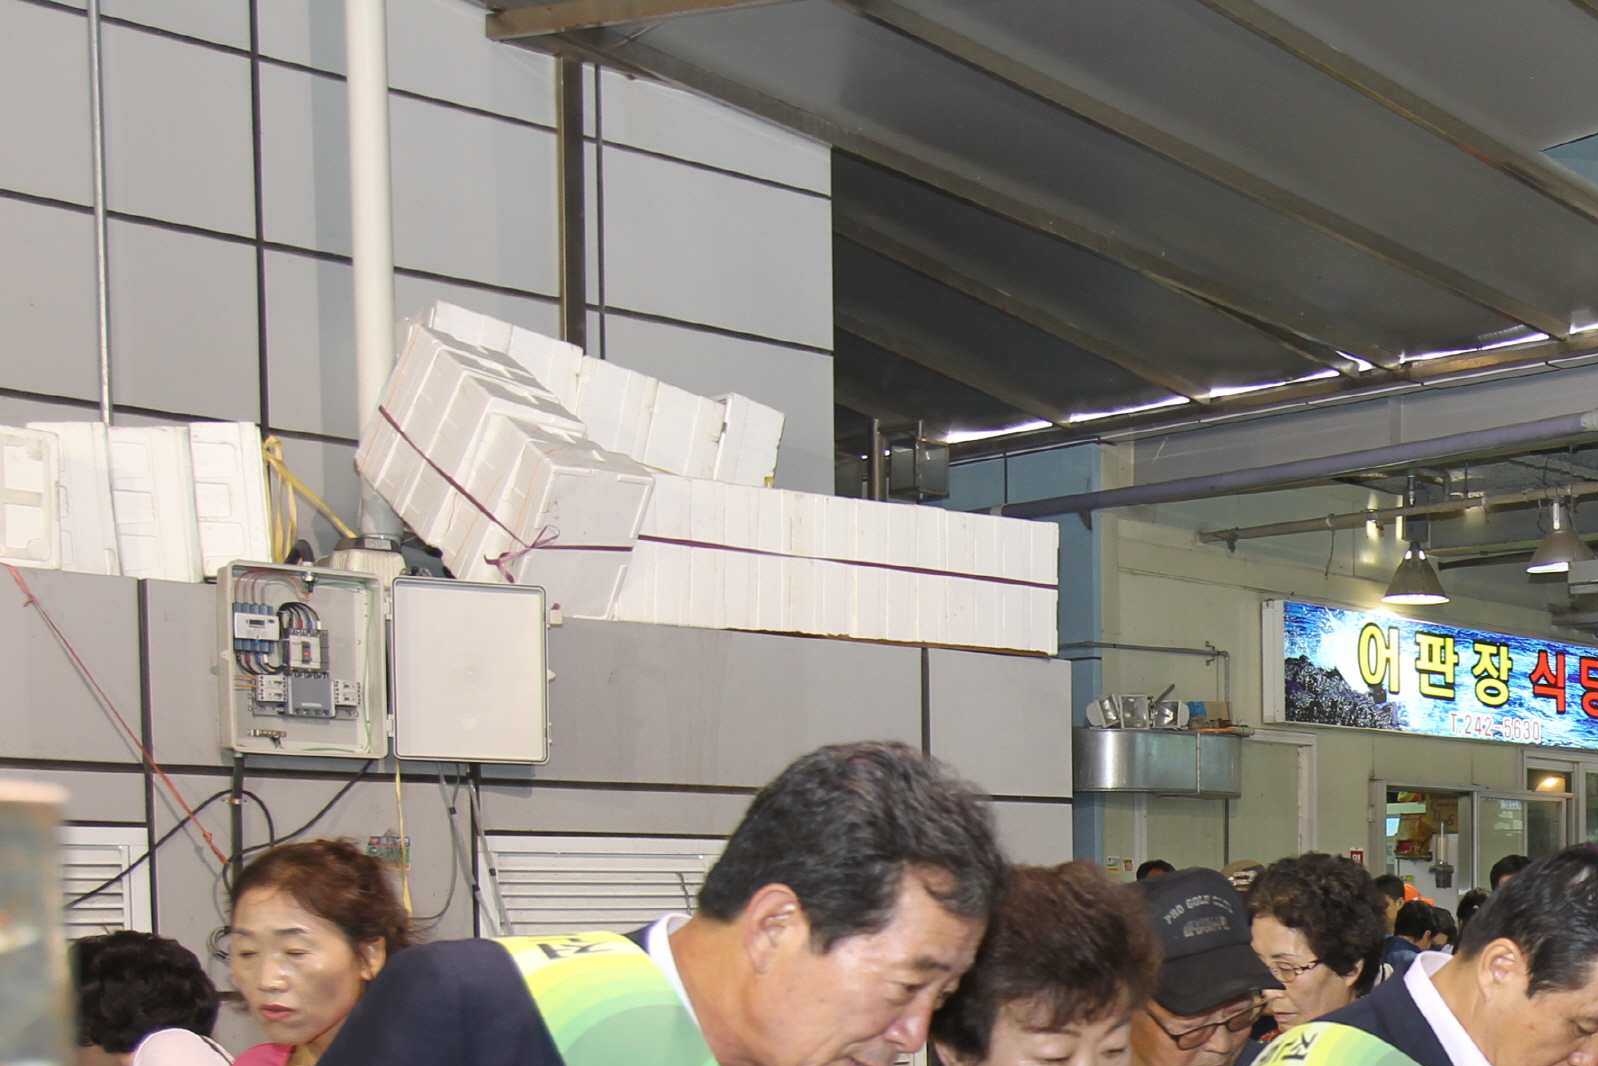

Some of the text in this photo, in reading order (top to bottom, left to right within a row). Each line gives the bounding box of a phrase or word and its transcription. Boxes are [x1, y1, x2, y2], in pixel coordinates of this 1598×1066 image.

[1358, 621, 1513, 708] 어판장
[1450, 711, 1542, 742] T.242-5630
[1185, 895, 1210, 909] GOLF
